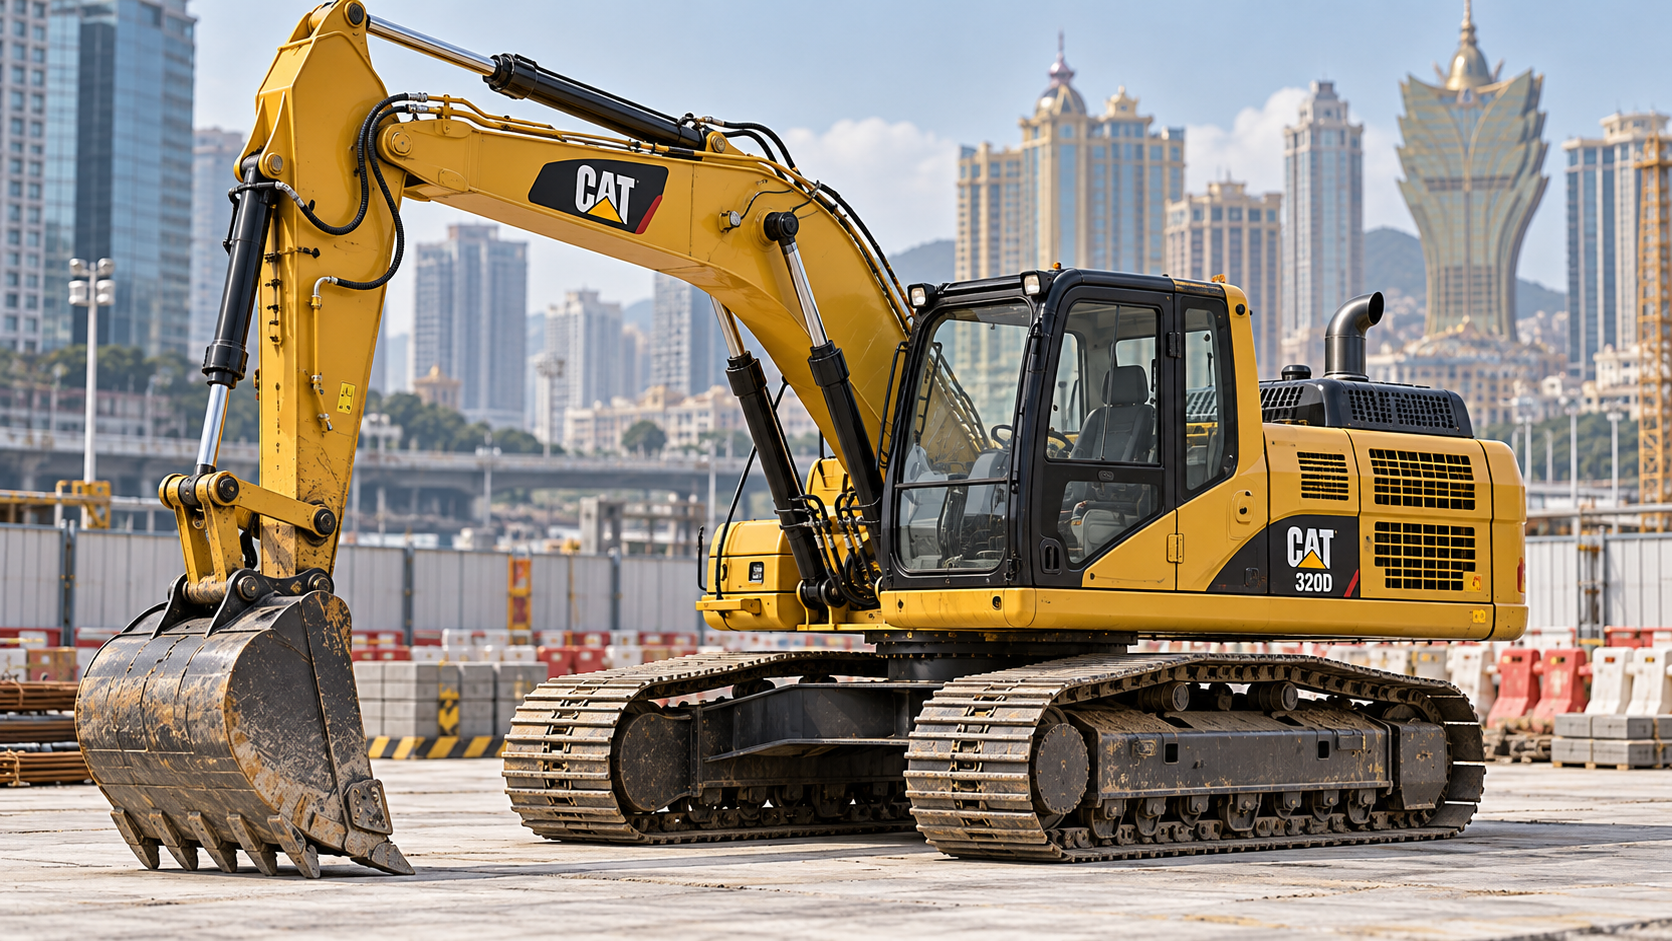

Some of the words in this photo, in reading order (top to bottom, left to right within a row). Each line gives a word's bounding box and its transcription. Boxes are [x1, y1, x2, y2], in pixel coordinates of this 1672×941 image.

[575, 164, 635, 225] CAT
[1287, 526, 1334, 569] CAT
[1295, 572, 1333, 592] 320D
